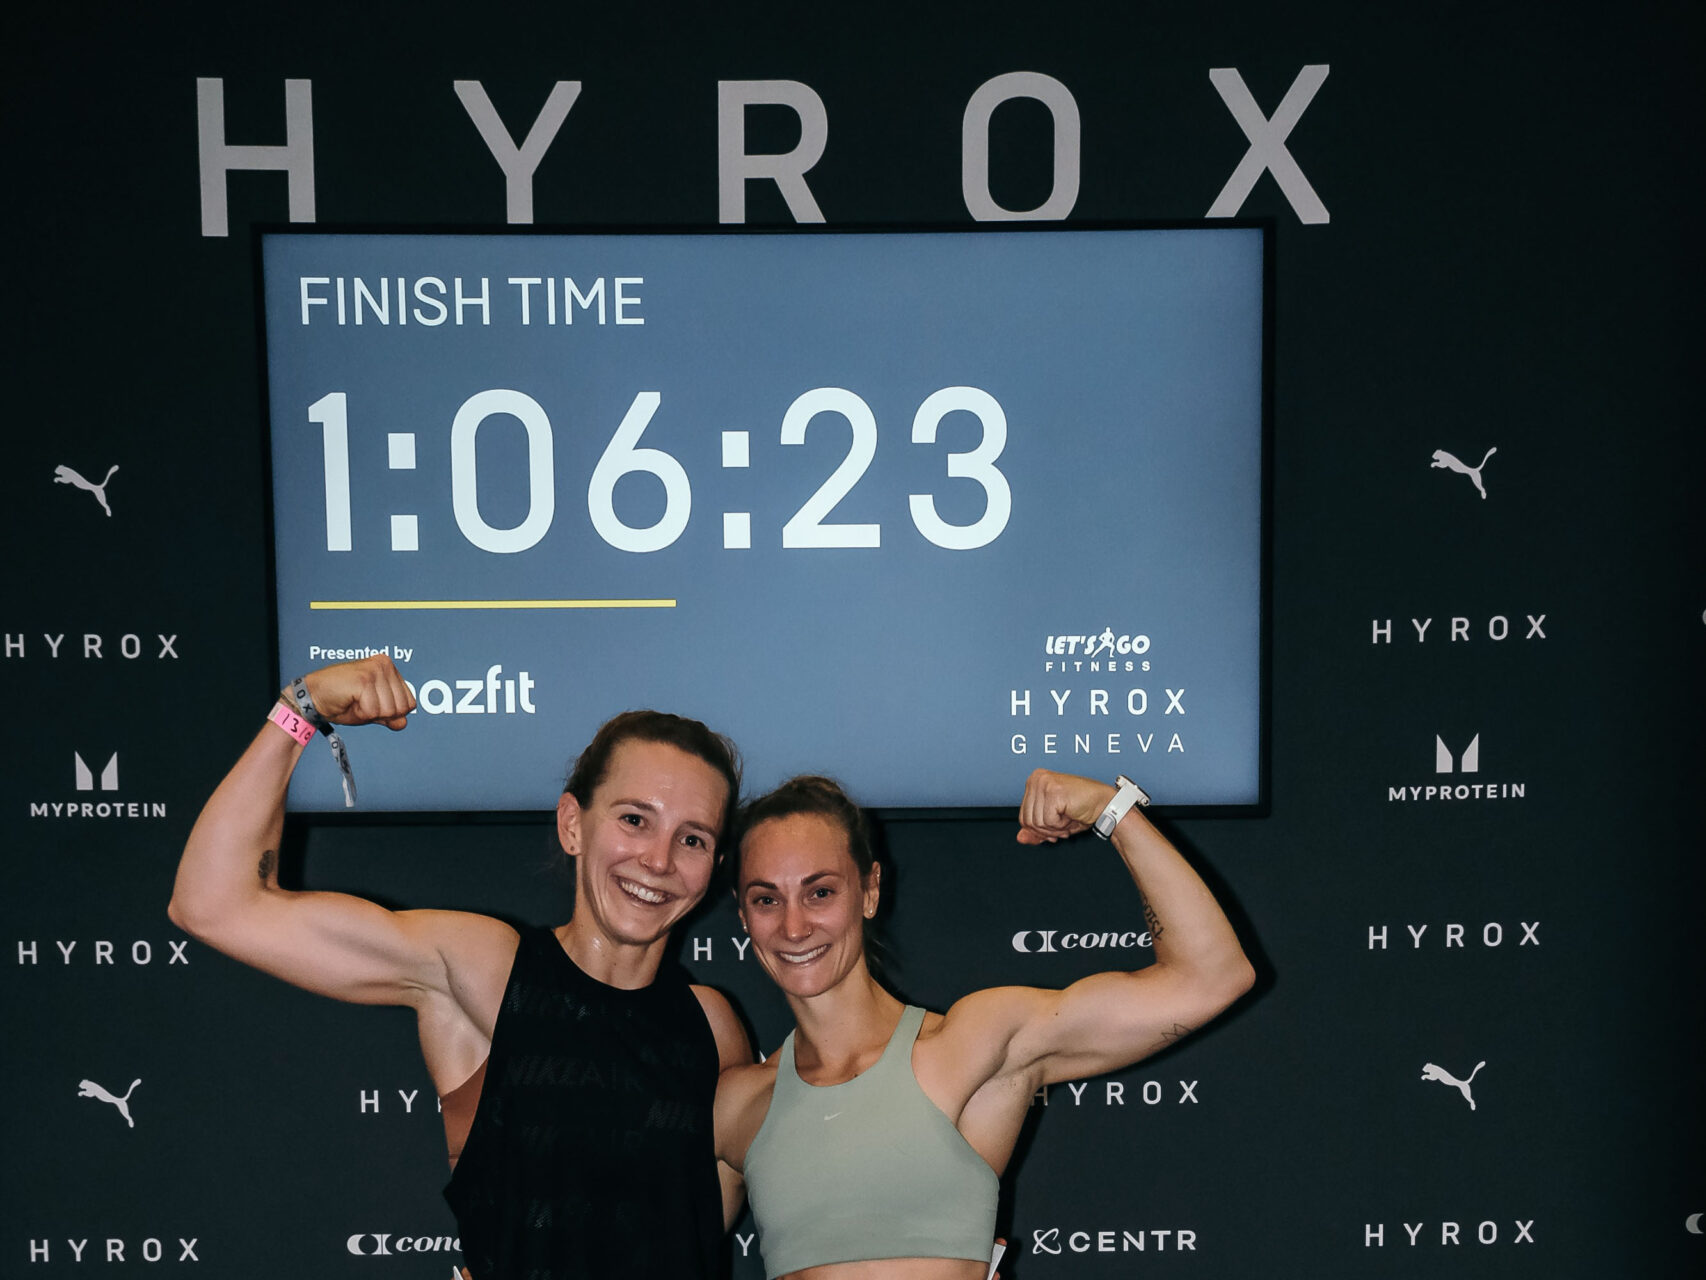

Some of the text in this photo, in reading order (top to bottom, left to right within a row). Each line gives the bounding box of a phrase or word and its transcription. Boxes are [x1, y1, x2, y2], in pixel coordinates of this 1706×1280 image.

[197, 64, 1331, 238] HYROX
[300, 276, 645, 327] FINISH TIME
[308, 386, 1012, 554] 1:06:23
[1372, 614, 1546, 644] HYROX
[4, 633, 179, 659] HYROX
[309, 645, 413, 662] Presented by
[1045, 634, 1151, 655] LET'S GO
[1045, 660, 1151, 672] FITNESS
[404, 664, 536, 715] azfit
[1010, 688, 1186, 716] HYROX
[1011, 733, 1185, 754] GENEVA
[1388, 783, 1525, 802] MYPROTEIN
[30, 802, 166, 818] MYPROTEIN
[1061, 931, 1153, 949] conce
[1368, 921, 1541, 950] HYROX
[17, 940, 190, 965] HYROX
[1032, 1080, 1199, 1106] HYROX
[1068, 1229, 1197, 1253] CENTR
[1365, 1219, 1535, 1247] HYROX
[30, 1237, 200, 1263] HYROX
